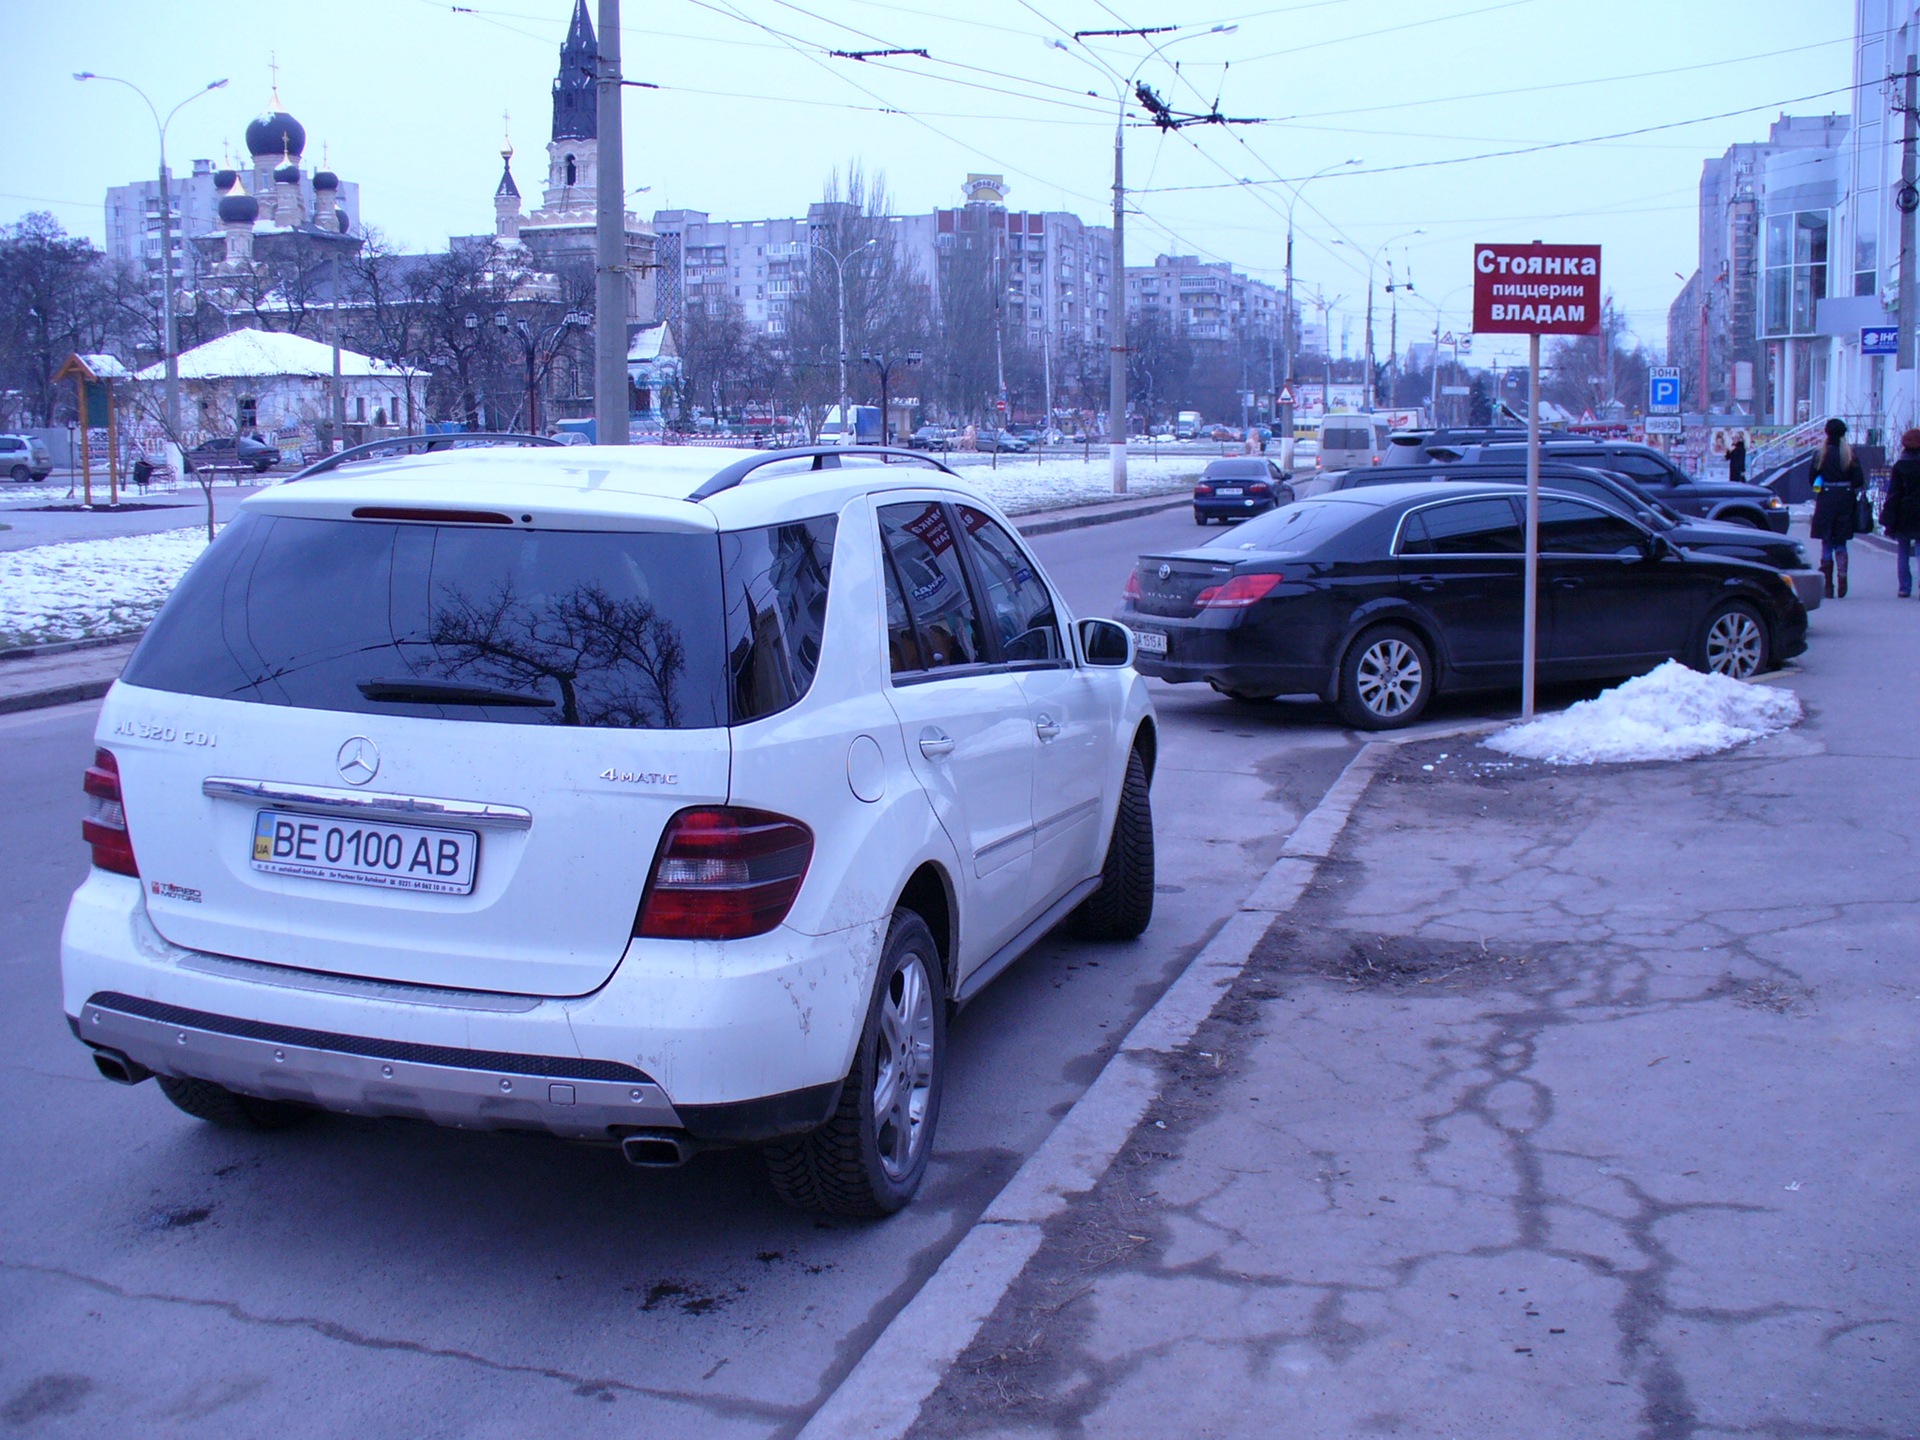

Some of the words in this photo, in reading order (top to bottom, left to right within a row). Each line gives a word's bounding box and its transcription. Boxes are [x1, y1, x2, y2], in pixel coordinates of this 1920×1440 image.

[1477, 249, 1597, 276] Стоянка
[1492, 284, 1584, 299] пиццерии
[1491, 304, 1585, 324] ВЛАДАМ
[1651, 368, 1678, 378] ЗОНА
[138, 722, 176, 742] 320
[182, 730, 217, 747] CDI
[256, 844, 269, 855] UA
[273, 821, 319, 861] BE
[325, 827, 403, 869] 0100
[408, 836, 460, 876] AB
[160, 882, 202, 897] TURBO
[160, 890, 203, 904] MOTORS
